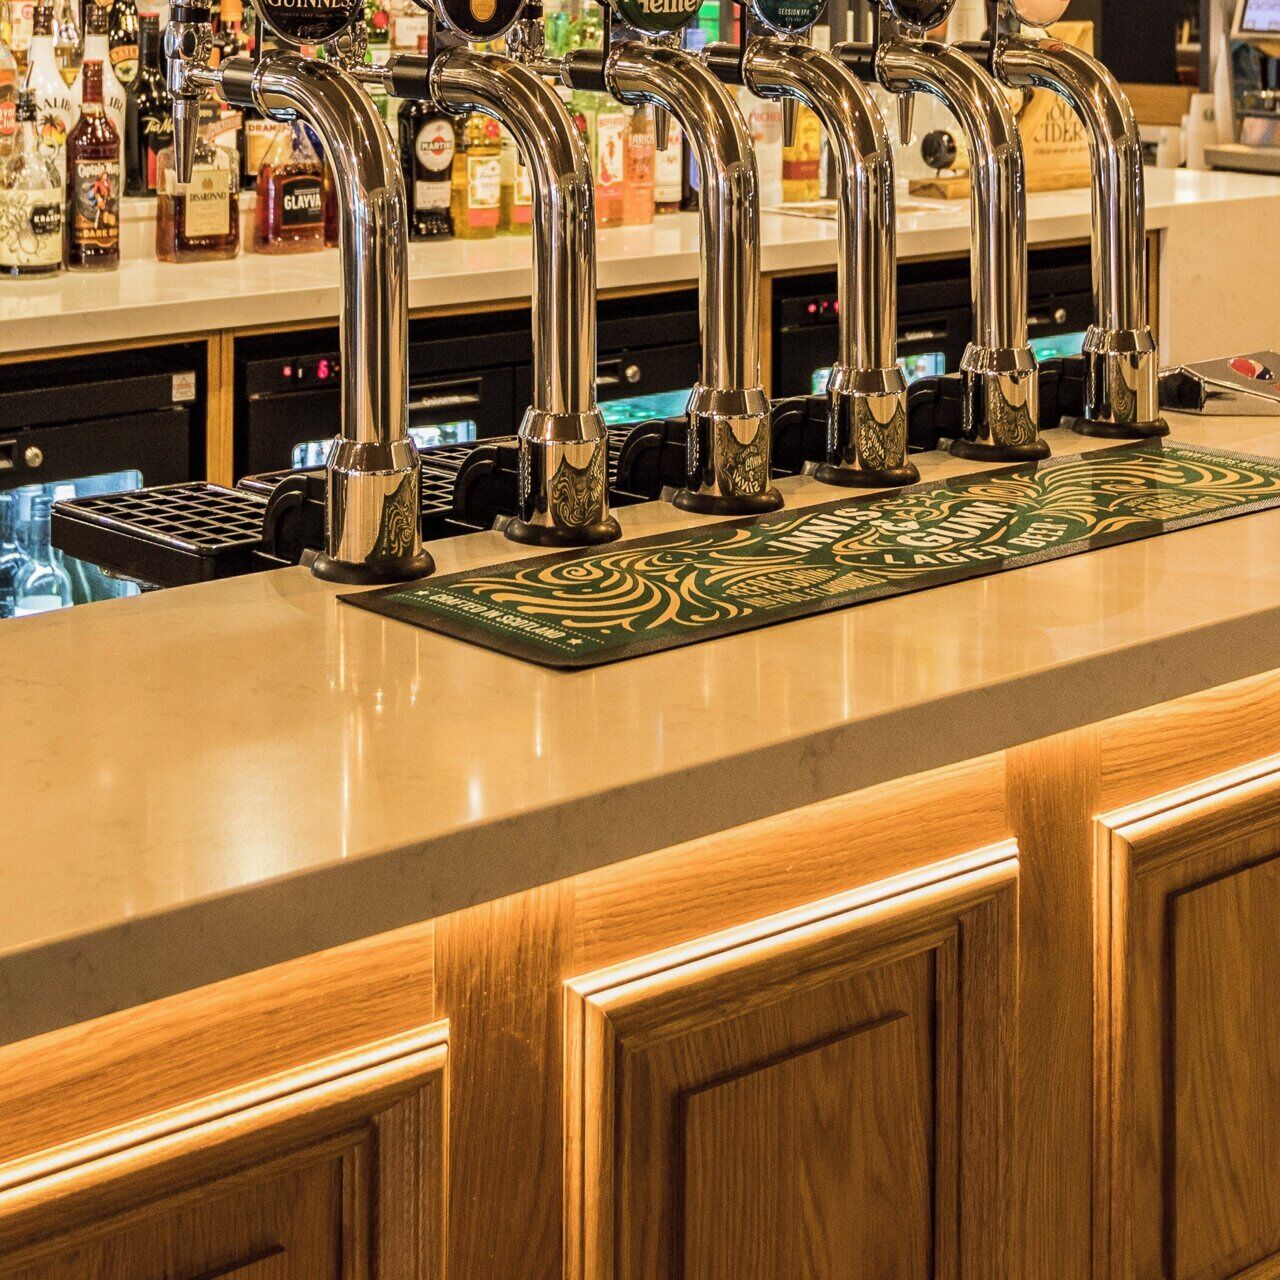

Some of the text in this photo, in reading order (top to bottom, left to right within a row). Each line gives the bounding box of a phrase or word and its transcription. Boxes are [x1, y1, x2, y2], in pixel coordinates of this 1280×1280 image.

[778, 8, 800, 16] SESSION
[78, 163, 105, 178] Captain
[189, 192, 227, 202] DISARONNO
[765, 507, 883, 553] INNIS
[869, 519, 920, 532] &
[896, 501, 1017, 548] GUNN
[883, 521, 1069, 566] LAGER BEER
[725, 568, 837, 596] REFRESHING
[429, 593, 567, 639] CRAFTED IN SCOTLAND
